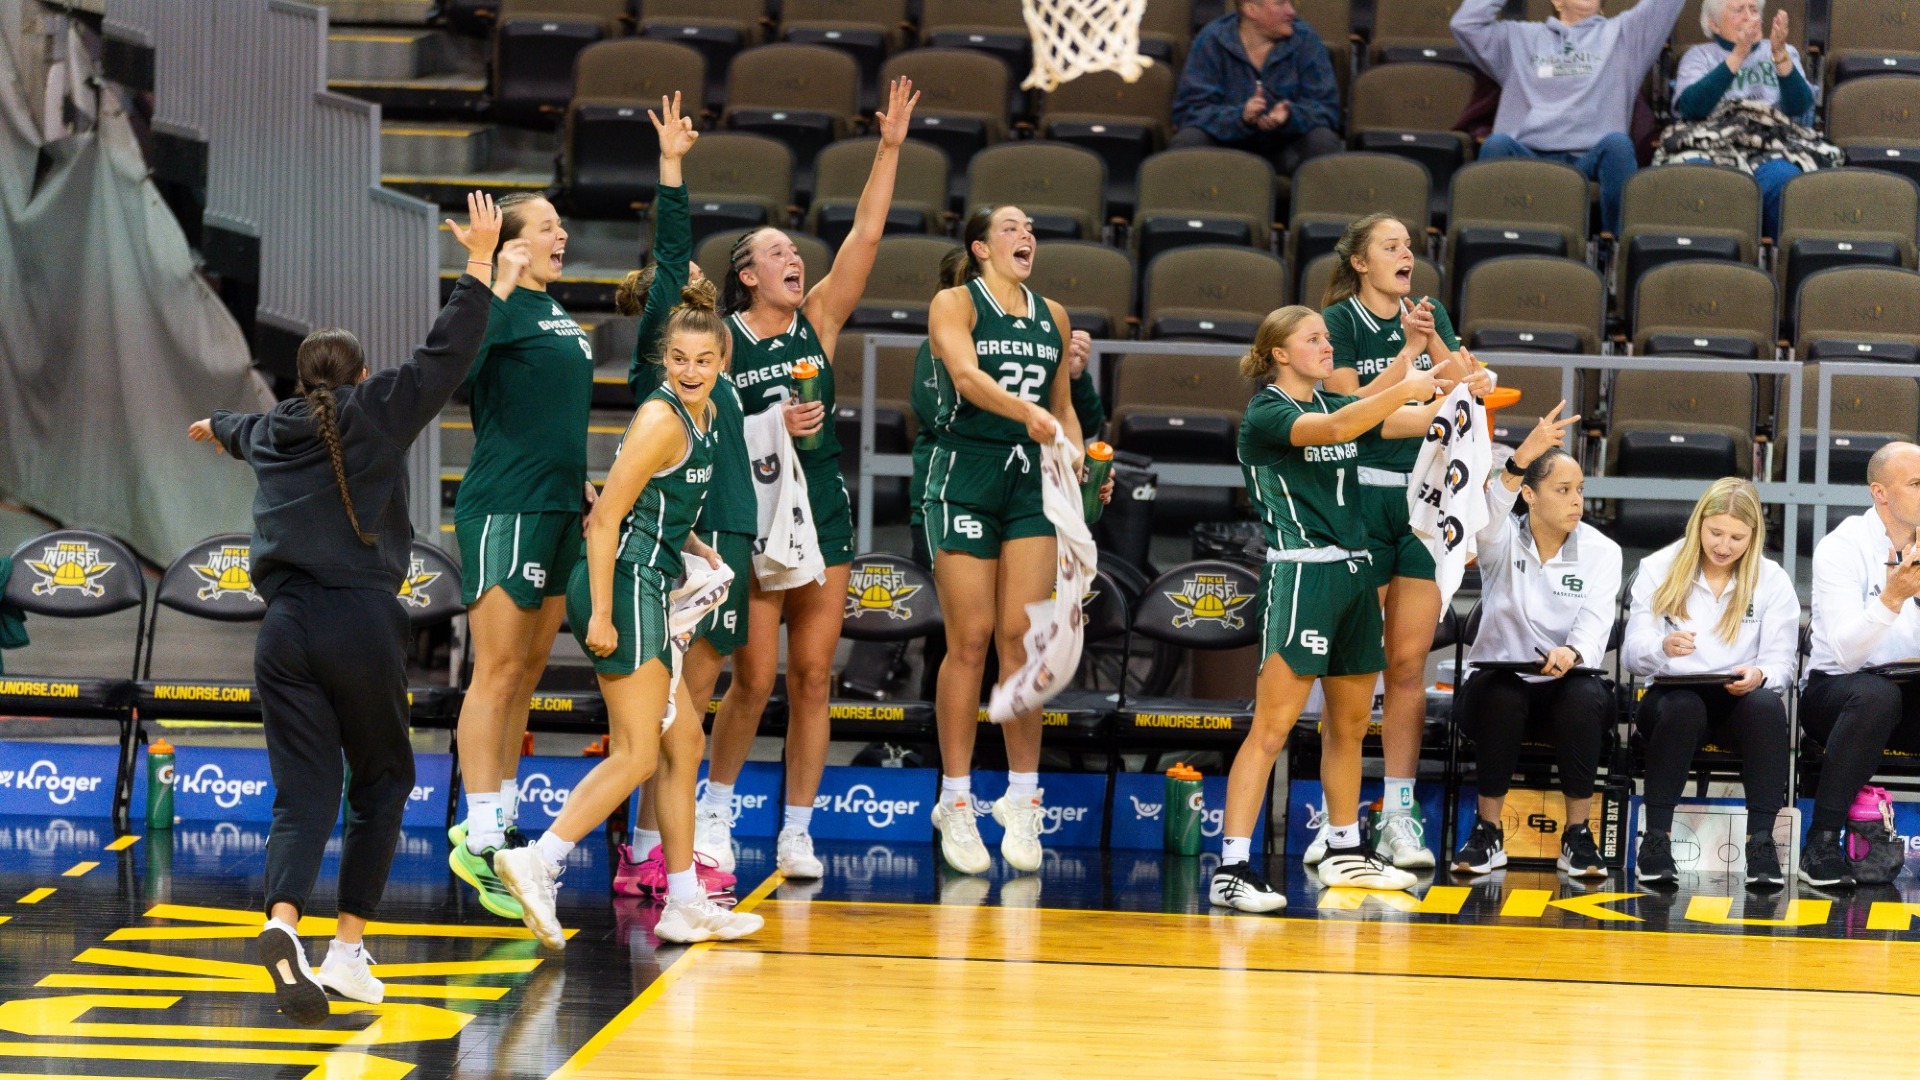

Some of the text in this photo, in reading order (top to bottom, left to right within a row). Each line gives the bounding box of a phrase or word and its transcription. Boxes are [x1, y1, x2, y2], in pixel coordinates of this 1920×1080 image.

[976, 339, 1059, 363] GREEN BAY
[1356, 353, 1434, 375] GRE BA
[735, 361, 793, 389] GREEN
[998, 361, 1047, 403] 22
[1304, 441, 1358, 462] GREEN BA
[686, 463, 713, 484] GRE
[1336, 467, 1346, 507] 1
[953, 514, 983, 539] GB
[60, 543, 85, 552] NKU
[224, 548, 250, 557] NKU
[49, 551, 96, 567] NORSE
[210, 556, 250, 570] NORS
[522, 561, 547, 589] GB
[865, 566, 891, 575] NKU
[1198, 576, 1224, 584] NKU
[852, 574, 901, 590] NORSE
[1184, 583, 1235, 599] NORSE
[1561, 574, 1584, 592] GB
[1552, 591, 1588, 600] BASKETBALL
[1300, 629, 1329, 656] GB
[0, 680, 79, 698] UNORSE.COM
[154, 685, 251, 702] NKUNORSE.COM
[530, 696, 573, 712] SE.COM
[829, 705, 904, 721] UNORSE.COM
[1135, 713, 1232, 730] NKUNORSE.COM
[16, 760, 101, 804] Kroger
[182, 763, 268, 808] Kroger
[519, 773, 570, 817] Krog
[731, 793, 768, 821] ger
[834, 784, 920, 828] Kroger
[1043, 806, 1088, 834] ger
[1527, 813, 1558, 834] GB
[1604, 800, 1619, 858] GREEN BAY
